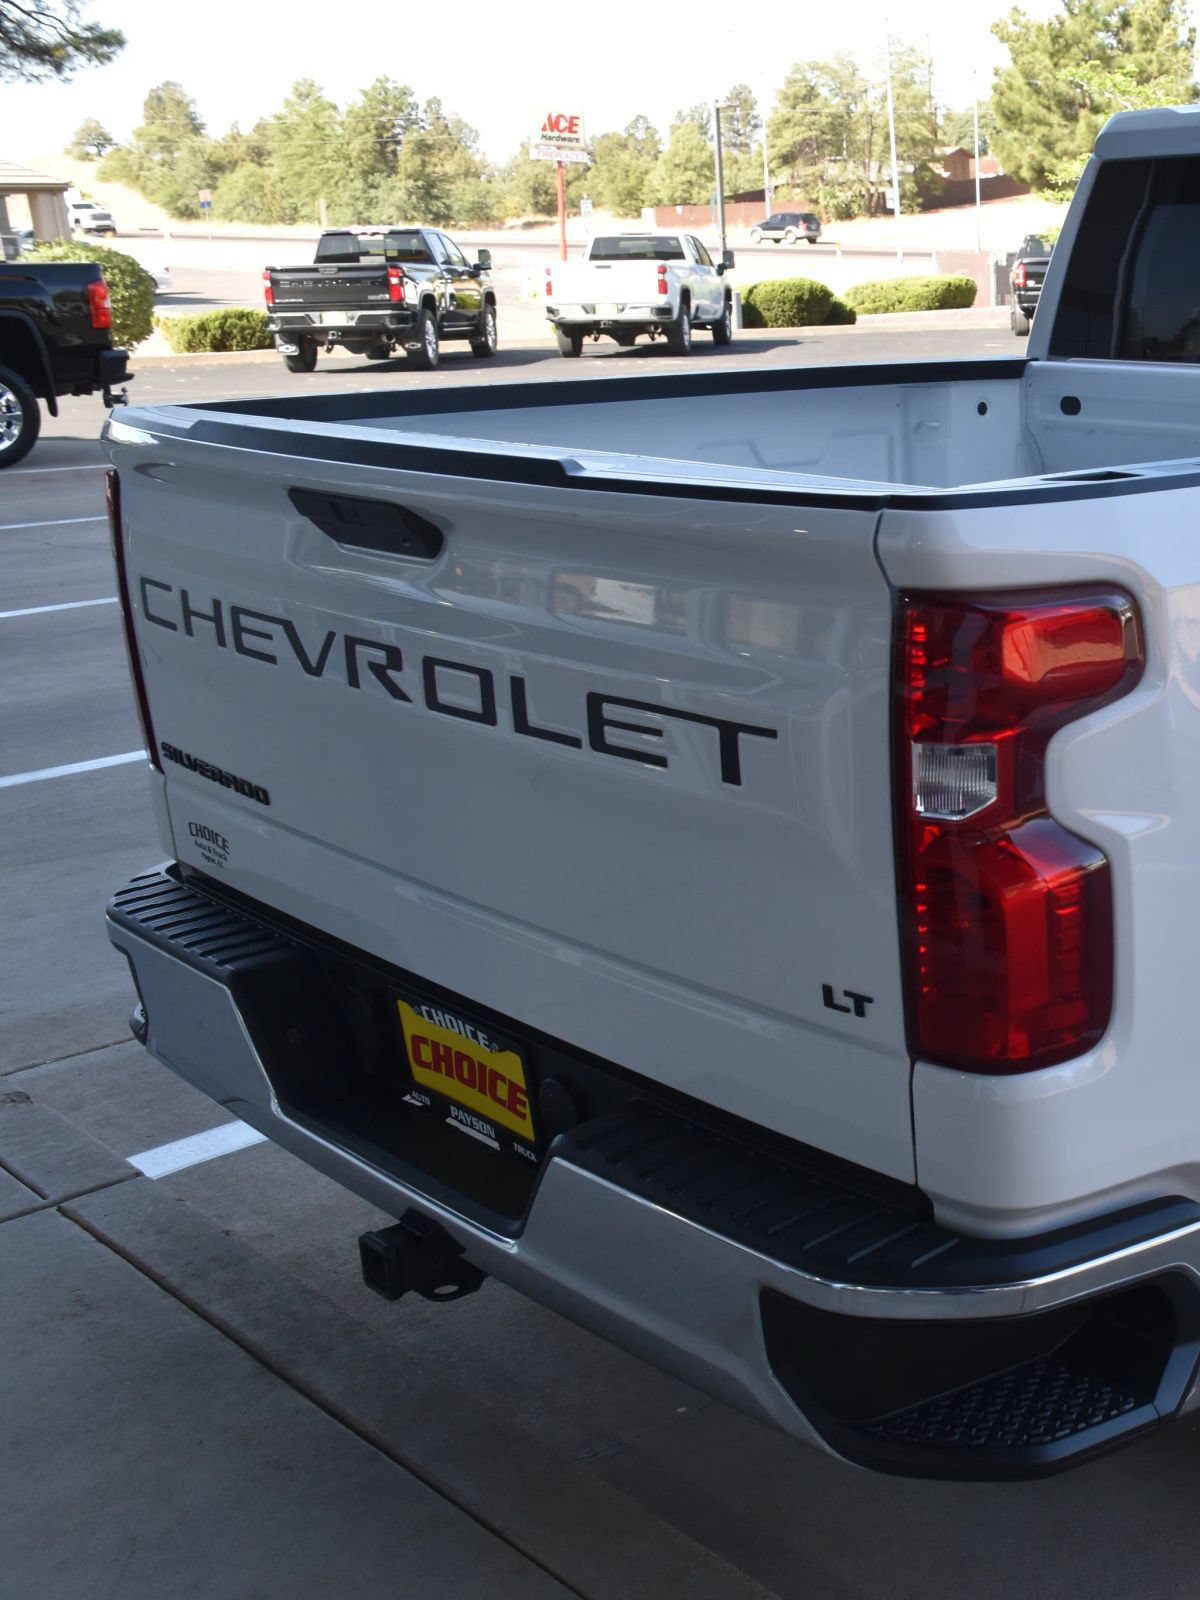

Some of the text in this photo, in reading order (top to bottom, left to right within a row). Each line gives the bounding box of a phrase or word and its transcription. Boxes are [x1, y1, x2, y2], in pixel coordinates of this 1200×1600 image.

[541, 111, 580, 134] ACE
[541, 133, 581, 144] Hardware
[536, 149, 586, 161] FIREPLACES
[139, 574, 779, 788] CHEVROLET
[160, 741, 272, 806] SILVERADO
[188, 822, 230, 855] CHOICE
[822, 983, 874, 1018] LT
[421, 1005, 491, 1052] CHOICE
[411, 1033, 528, 1121] CHOICE
[411, 1090, 431, 1106] AUTO
[449, 1105, 497, 1139] PAYSON
[513, 1141, 537, 1163] TRUCK
